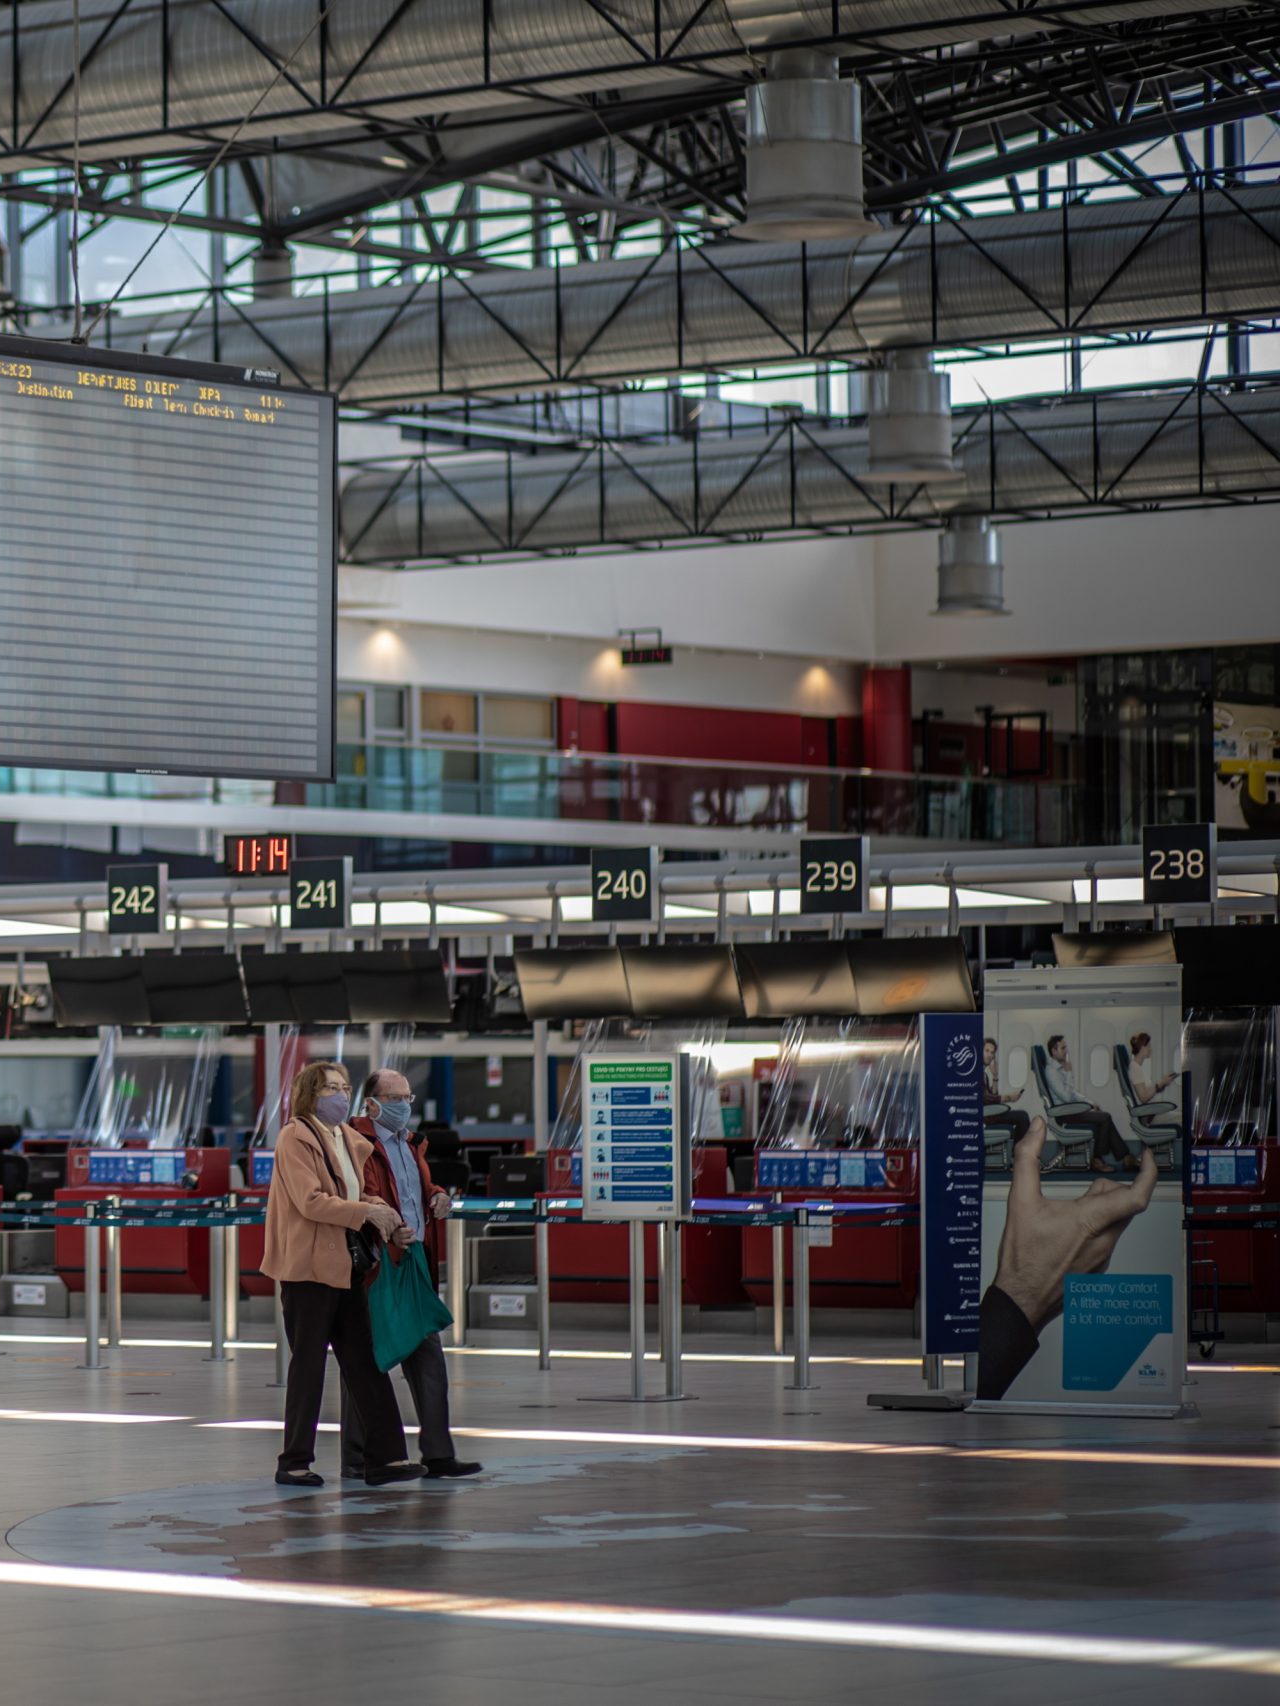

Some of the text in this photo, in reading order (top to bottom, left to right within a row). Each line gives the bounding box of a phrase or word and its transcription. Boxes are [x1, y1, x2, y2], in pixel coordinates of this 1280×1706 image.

[18, 382, 73, 400] Destination
[124, 394, 153, 409] Flight
[238, 838, 288, 872] 11:14
[1149, 849, 1205, 880] 238
[596, 869, 647, 900] 240
[805, 860, 857, 892] 239
[111, 885, 156, 915] 242
[296, 879, 337, 910] 241
[1070, 1281, 1115, 1295] Economy
[1070, 1298, 1077, 1309] A
[1081, 1297, 1101, 1309] little
[1104, 1299, 1130, 1309] more
[1070, 1315, 1076, 1324] a
[1080, 1313, 1092, 1324] lot
[1096, 1315, 1121, 1324] more
[1138, 1369, 1157, 1377] KLM
